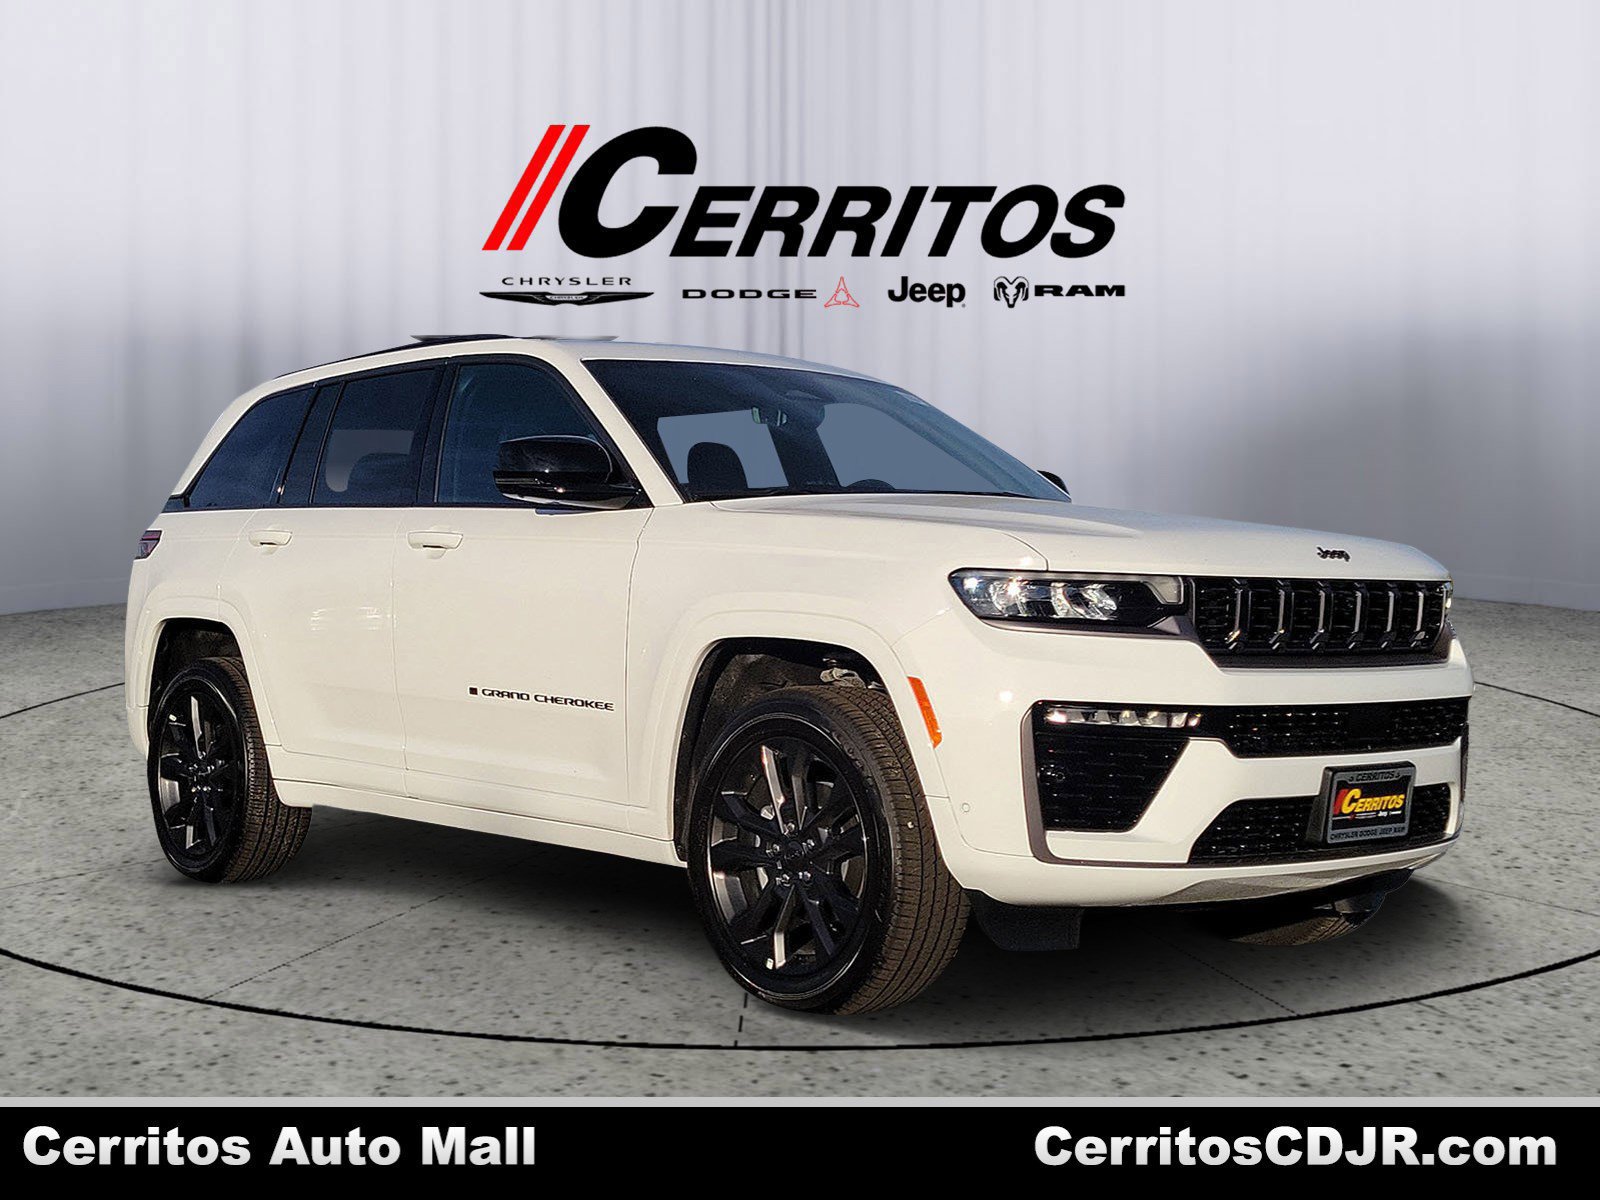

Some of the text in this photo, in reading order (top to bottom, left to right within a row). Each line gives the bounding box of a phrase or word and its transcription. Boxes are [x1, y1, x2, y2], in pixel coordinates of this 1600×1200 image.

[1316, 546, 1351, 562] Jeep
[481, 688, 614, 711] GRAND CHEROKEE
[1355, 770, 1395, 781] CERRITOS
[1341, 788, 1405, 814] CERRITOS
